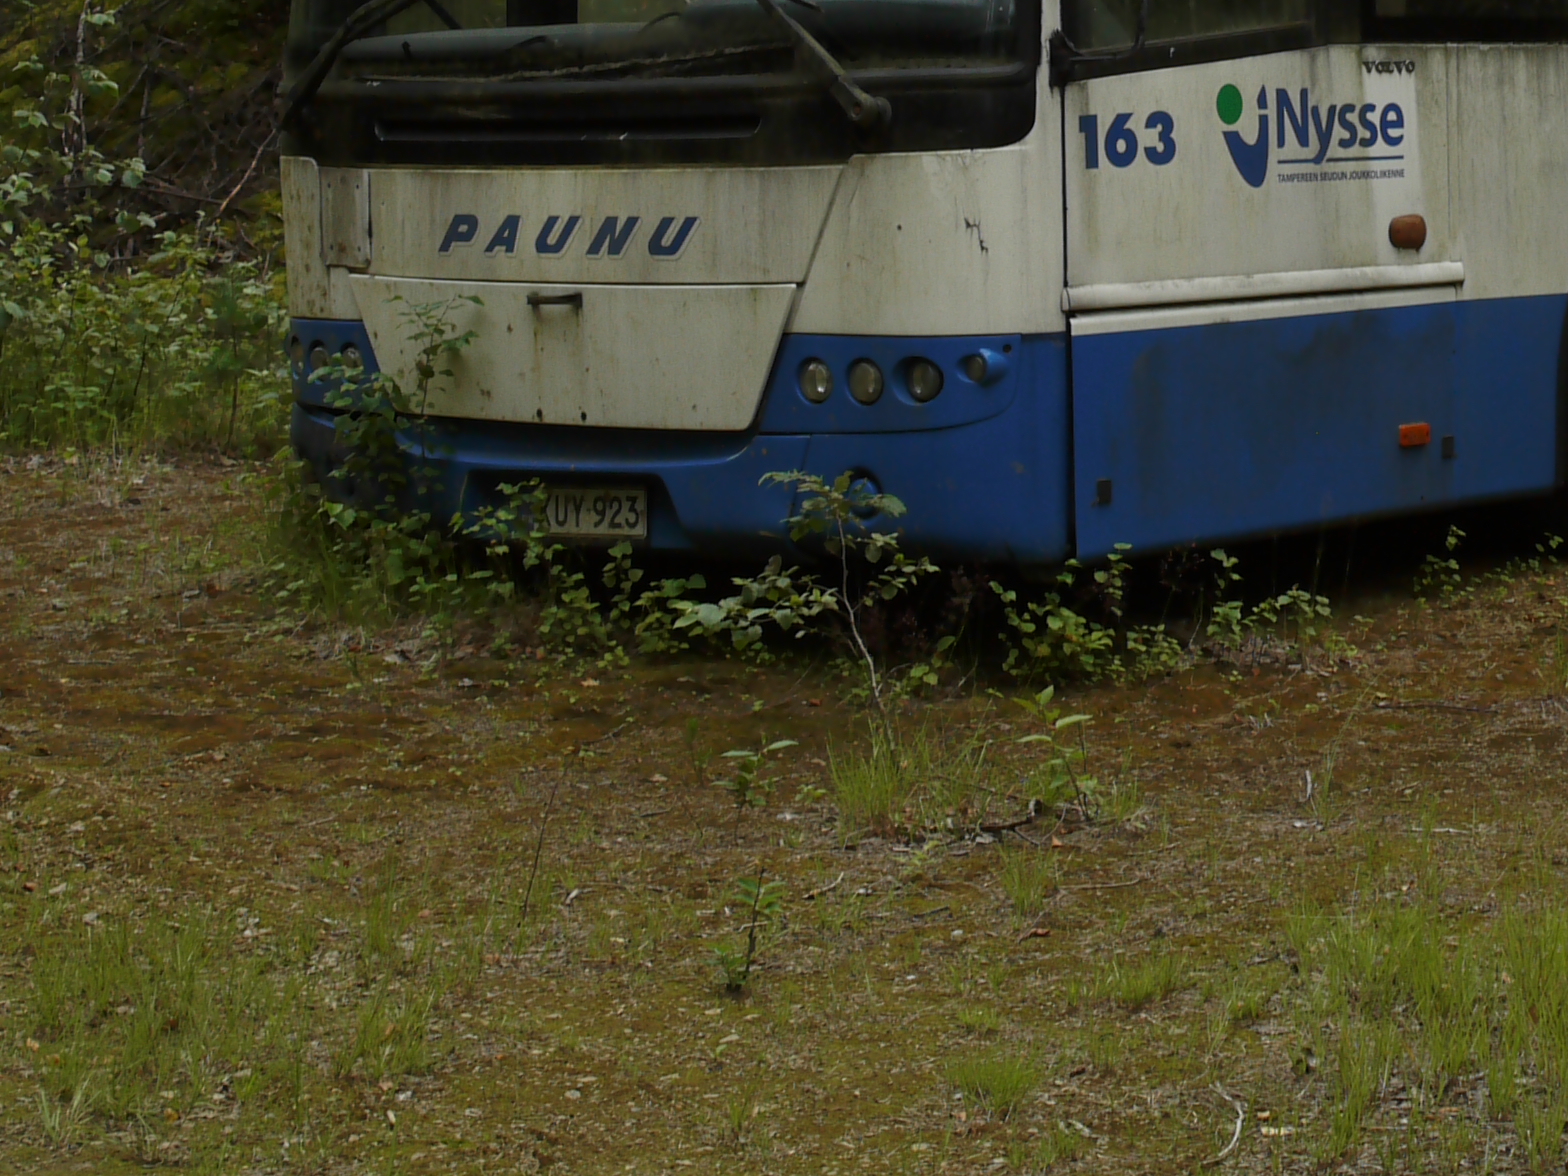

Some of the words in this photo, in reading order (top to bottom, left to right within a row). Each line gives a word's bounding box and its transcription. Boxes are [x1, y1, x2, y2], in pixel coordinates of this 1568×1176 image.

[1362, 60, 1415, 74] VOLVO
[1078, 110, 1177, 170] 163
[1275, 87, 1405, 165] Nysse
[1277, 172, 1319, 183] TAMPEREEN
[1320, 170, 1348, 182] SEUDUN
[1348, 168, 1405, 180] JOUKKOLIIKENNE
[437, 213, 700, 257] PAUNU
